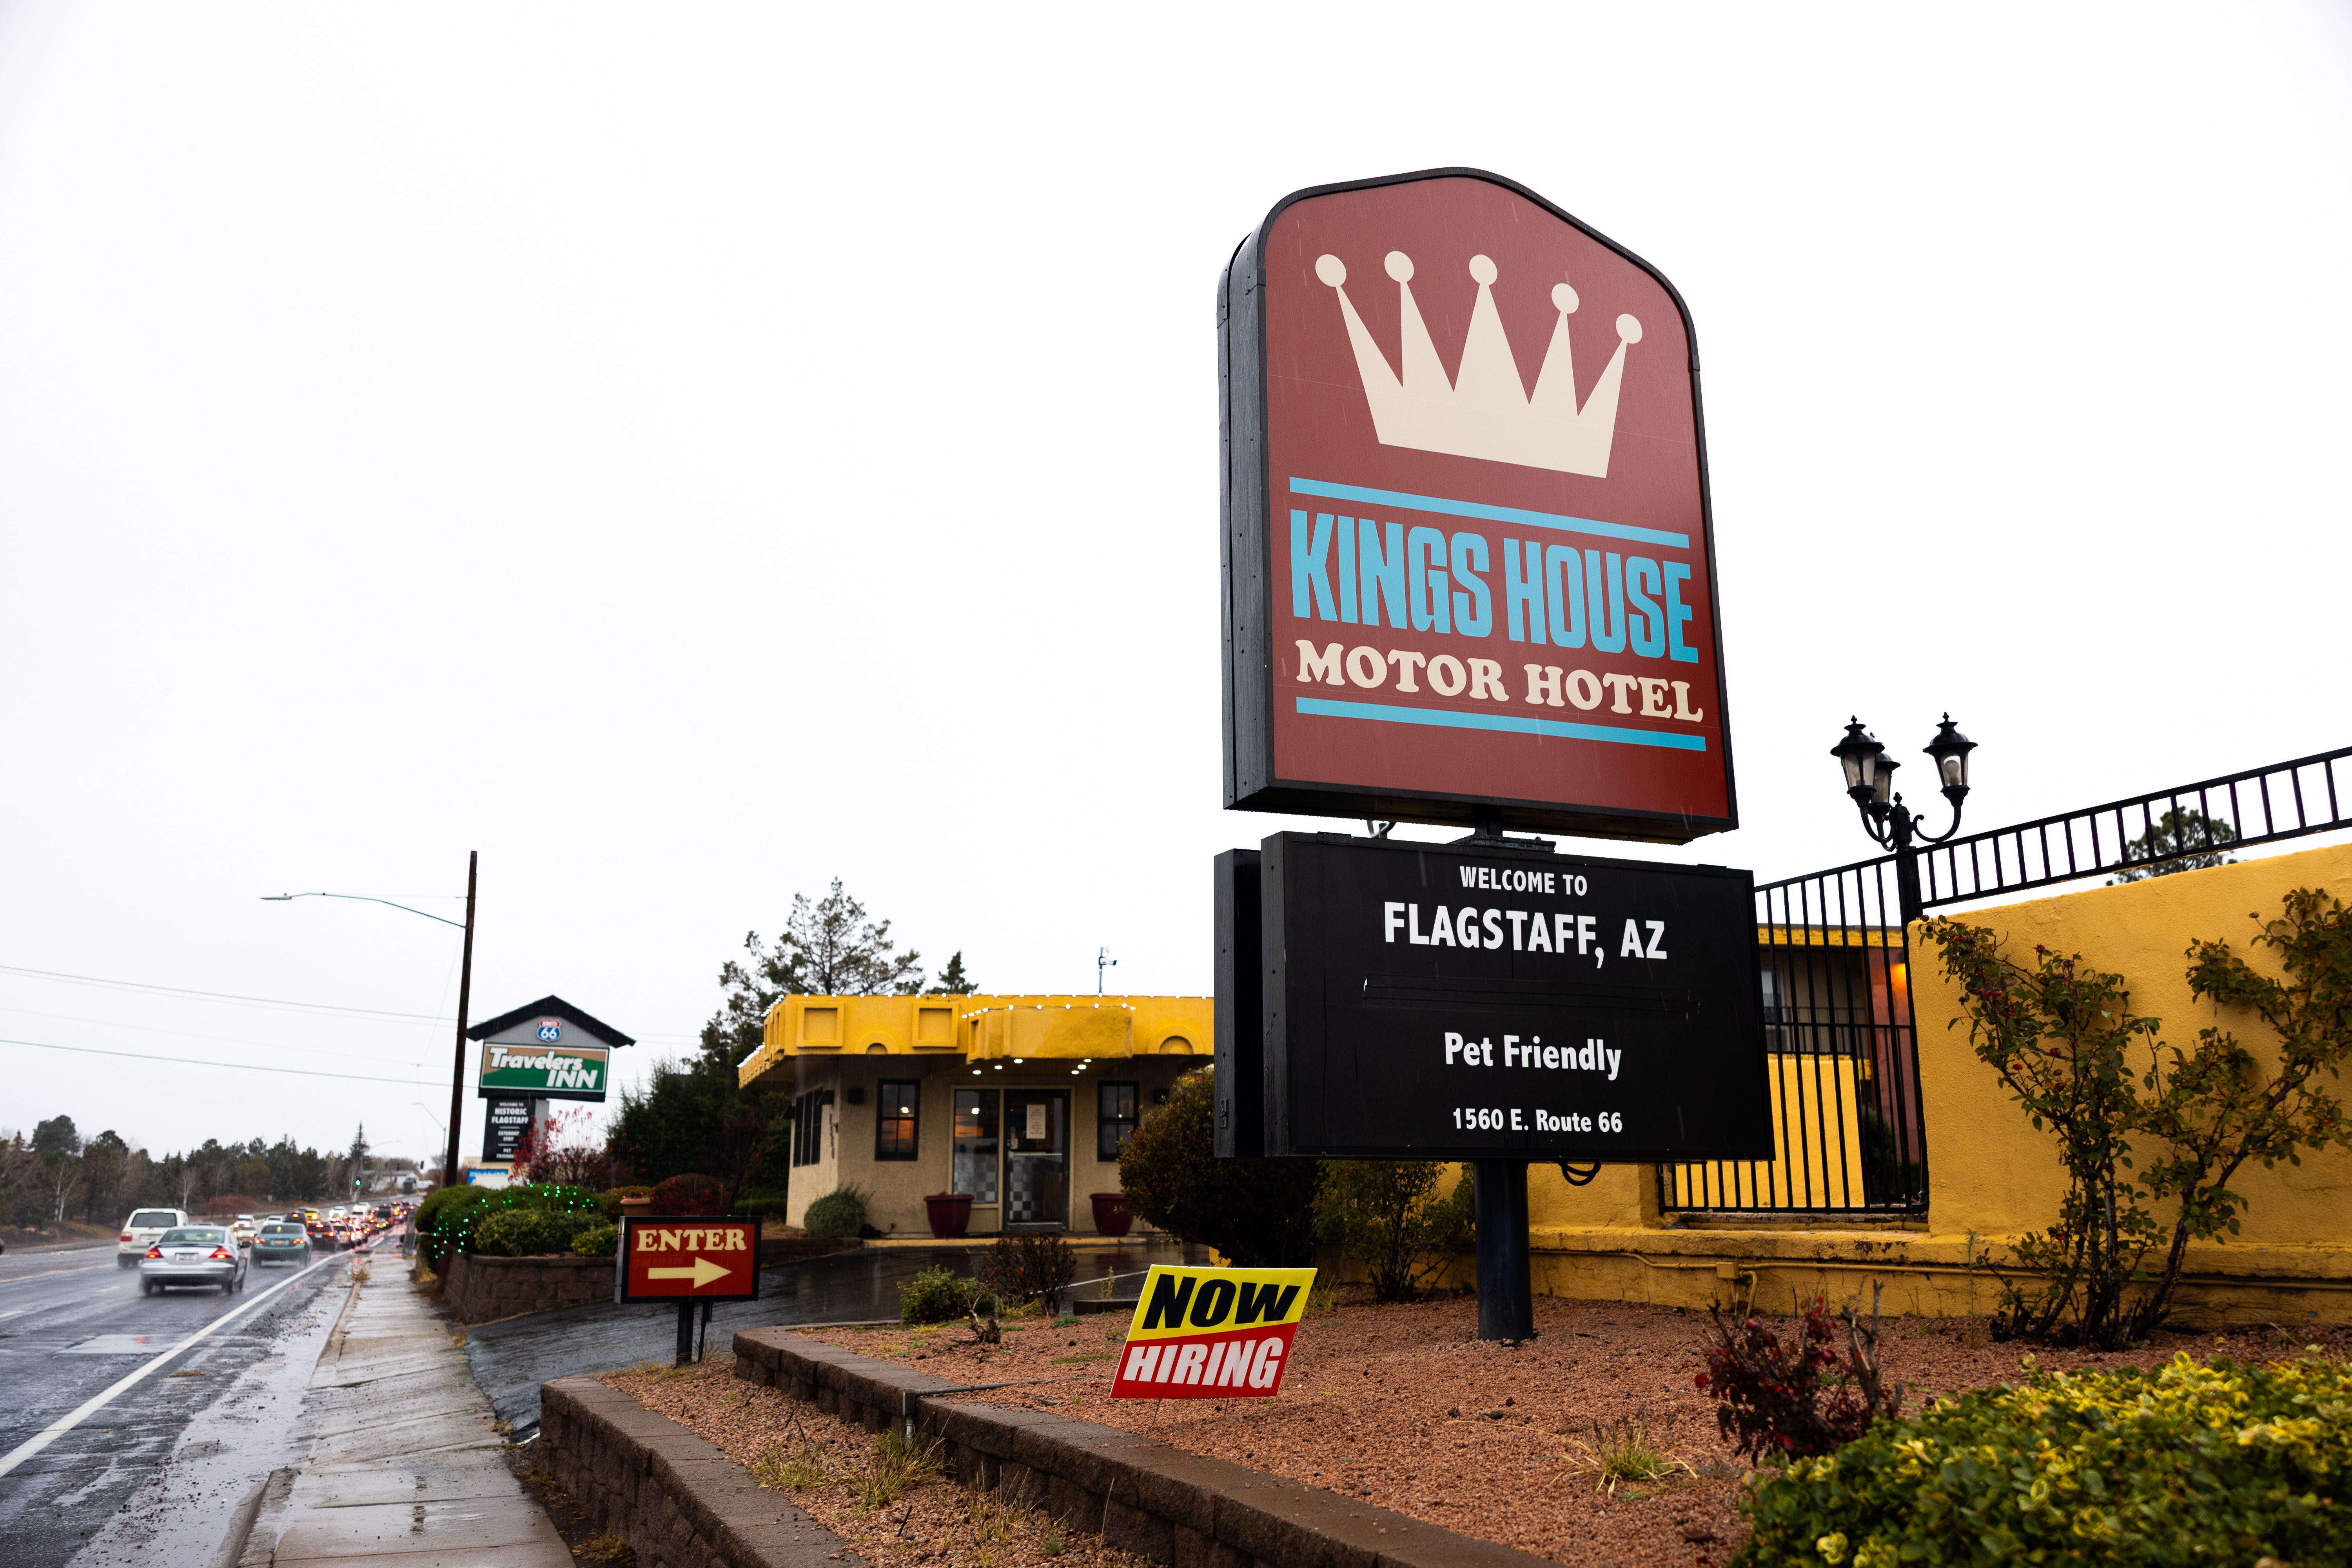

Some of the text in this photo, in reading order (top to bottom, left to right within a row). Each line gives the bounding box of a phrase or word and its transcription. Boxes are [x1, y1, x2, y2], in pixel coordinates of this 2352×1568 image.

[1290, 509, 1699, 663] KINGS HOUSE
[1295, 639, 1703, 722] MOTOR HOTEL
[1459, 866, 1587, 896] WELCOME TO
[1385, 902, 1668, 969] FLAGSTAFF, AZ
[541, 1027, 557, 1039] 66
[490, 1047, 583, 1071] Travelers
[1445, 1032, 1621, 1081] Pet Friendly
[546, 1069, 598, 1089] INN
[1453, 1108, 1622, 1133] 1560 E. Route 66
[636, 1229, 747, 1251] ENTER
[1142, 1273, 1301, 1330] NOW
[1122, 1337, 1284, 1388] HIRING
